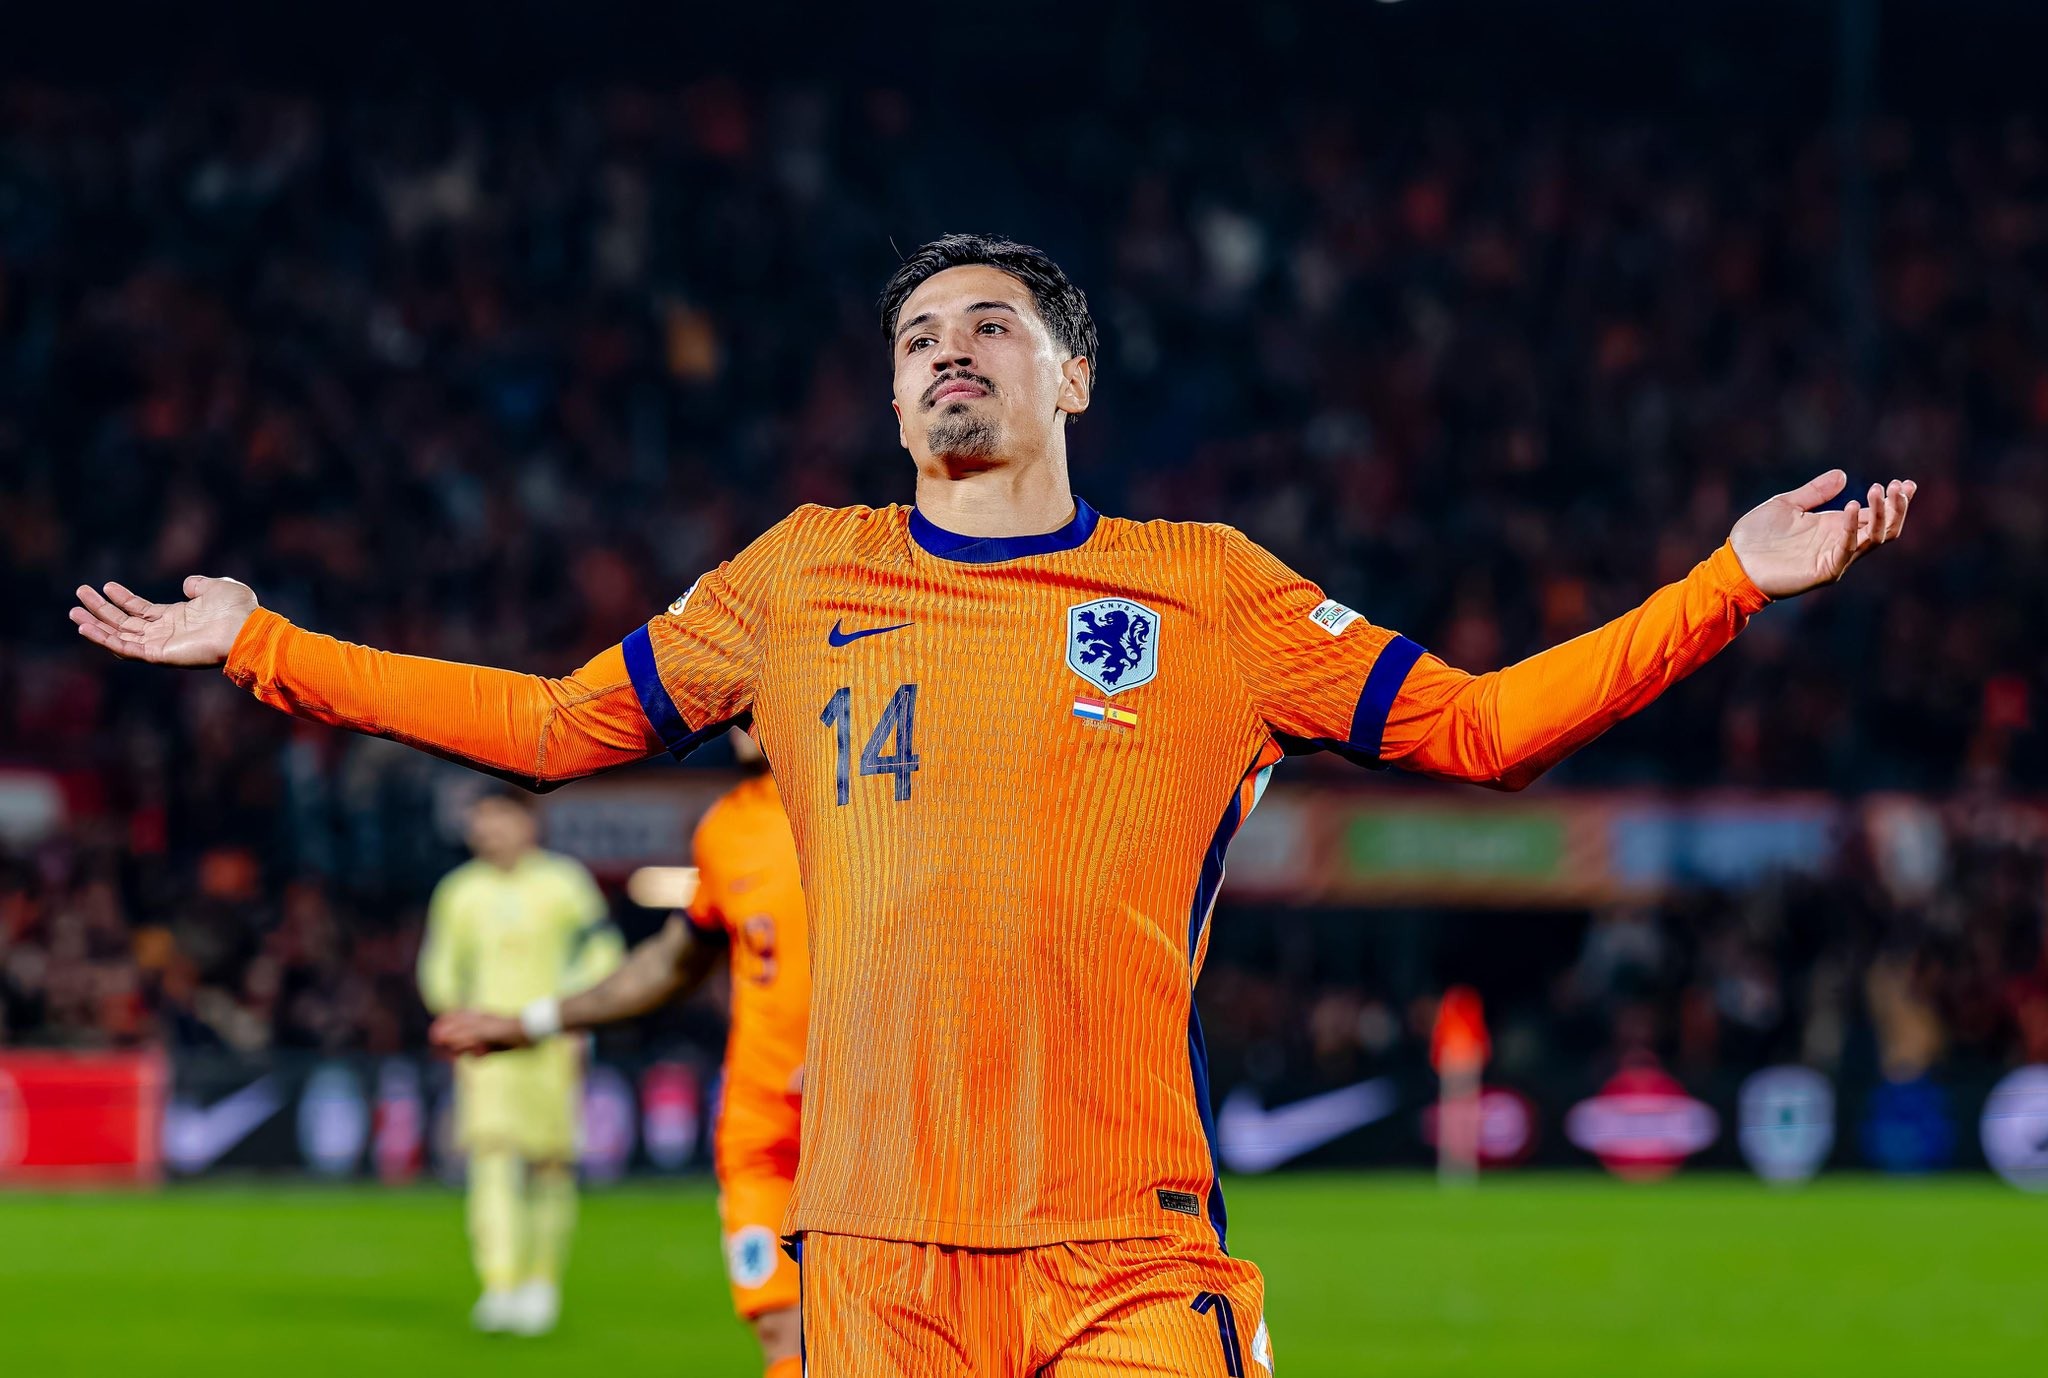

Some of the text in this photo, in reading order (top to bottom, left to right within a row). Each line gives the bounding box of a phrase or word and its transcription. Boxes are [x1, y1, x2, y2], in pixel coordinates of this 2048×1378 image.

[1312, 605, 1327, 620] UEFA
[819, 683, 920, 806] 14
[743, 909, 776, 981] 9
